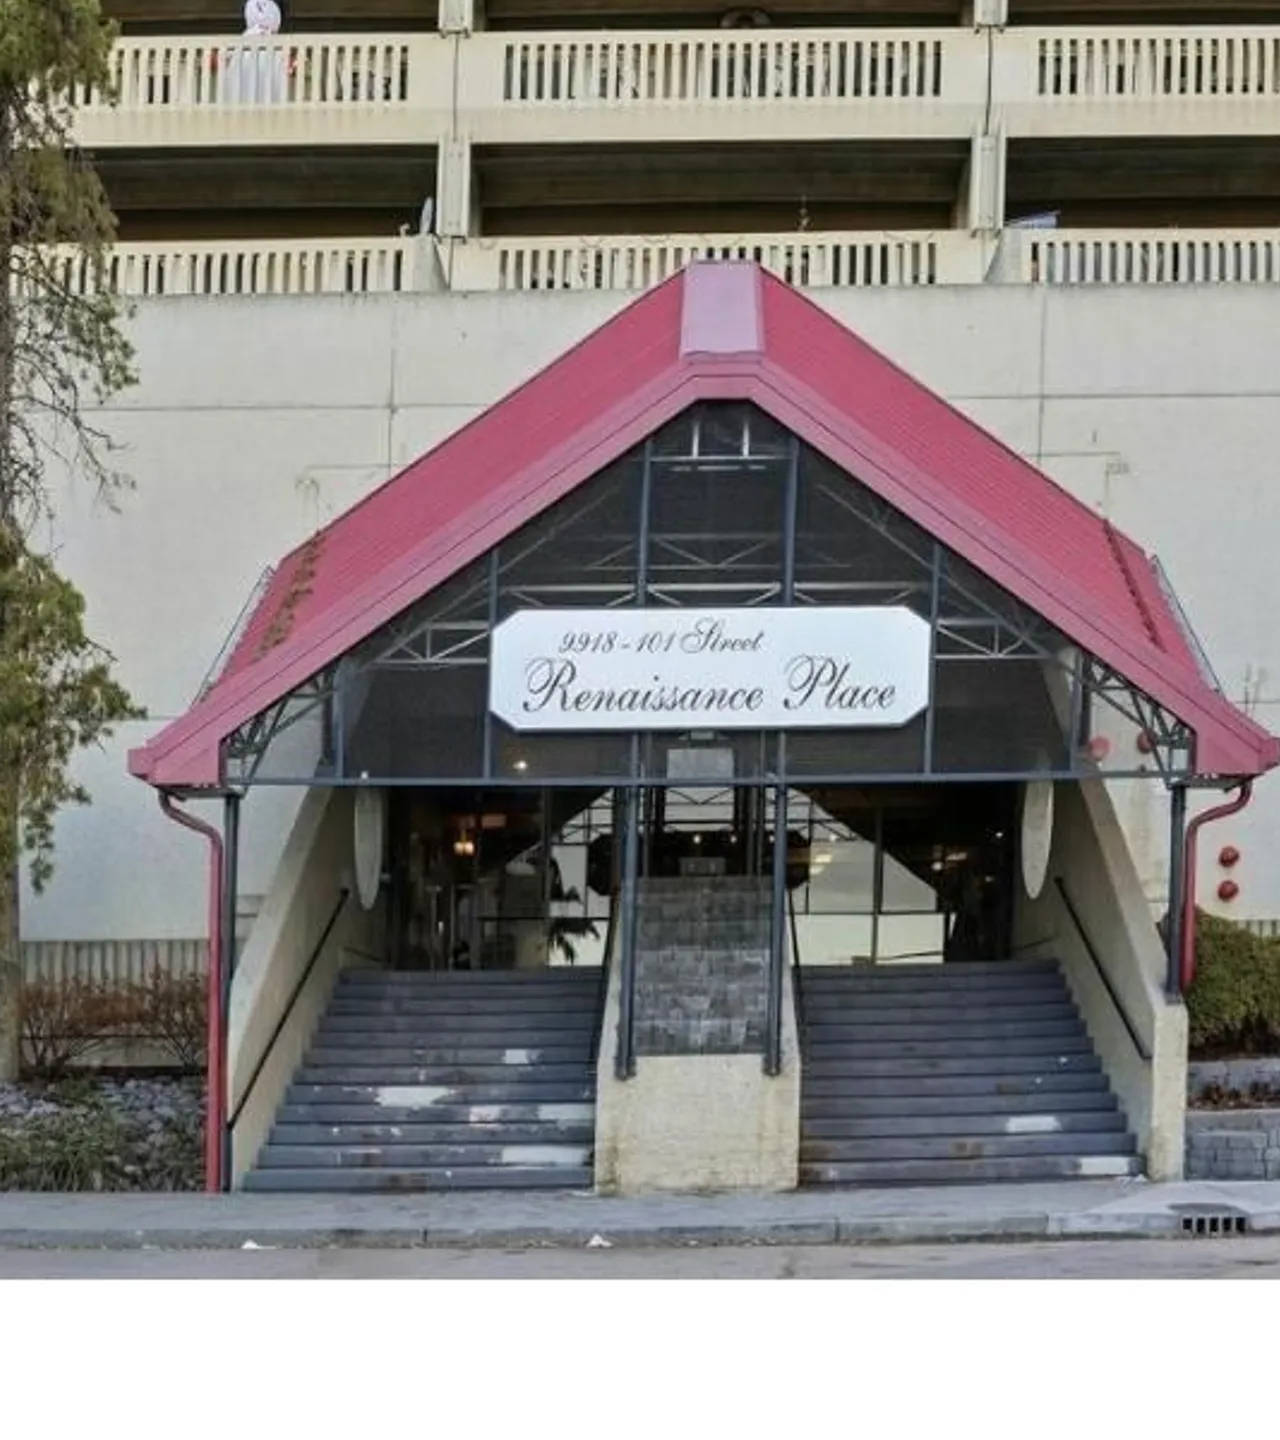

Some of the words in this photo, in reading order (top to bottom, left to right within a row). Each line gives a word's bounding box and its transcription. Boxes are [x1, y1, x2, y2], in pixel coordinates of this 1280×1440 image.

[679, 616, 765, 655] Street
[522, 658, 764, 713] Renaissance
[783, 654, 896, 711] Place
